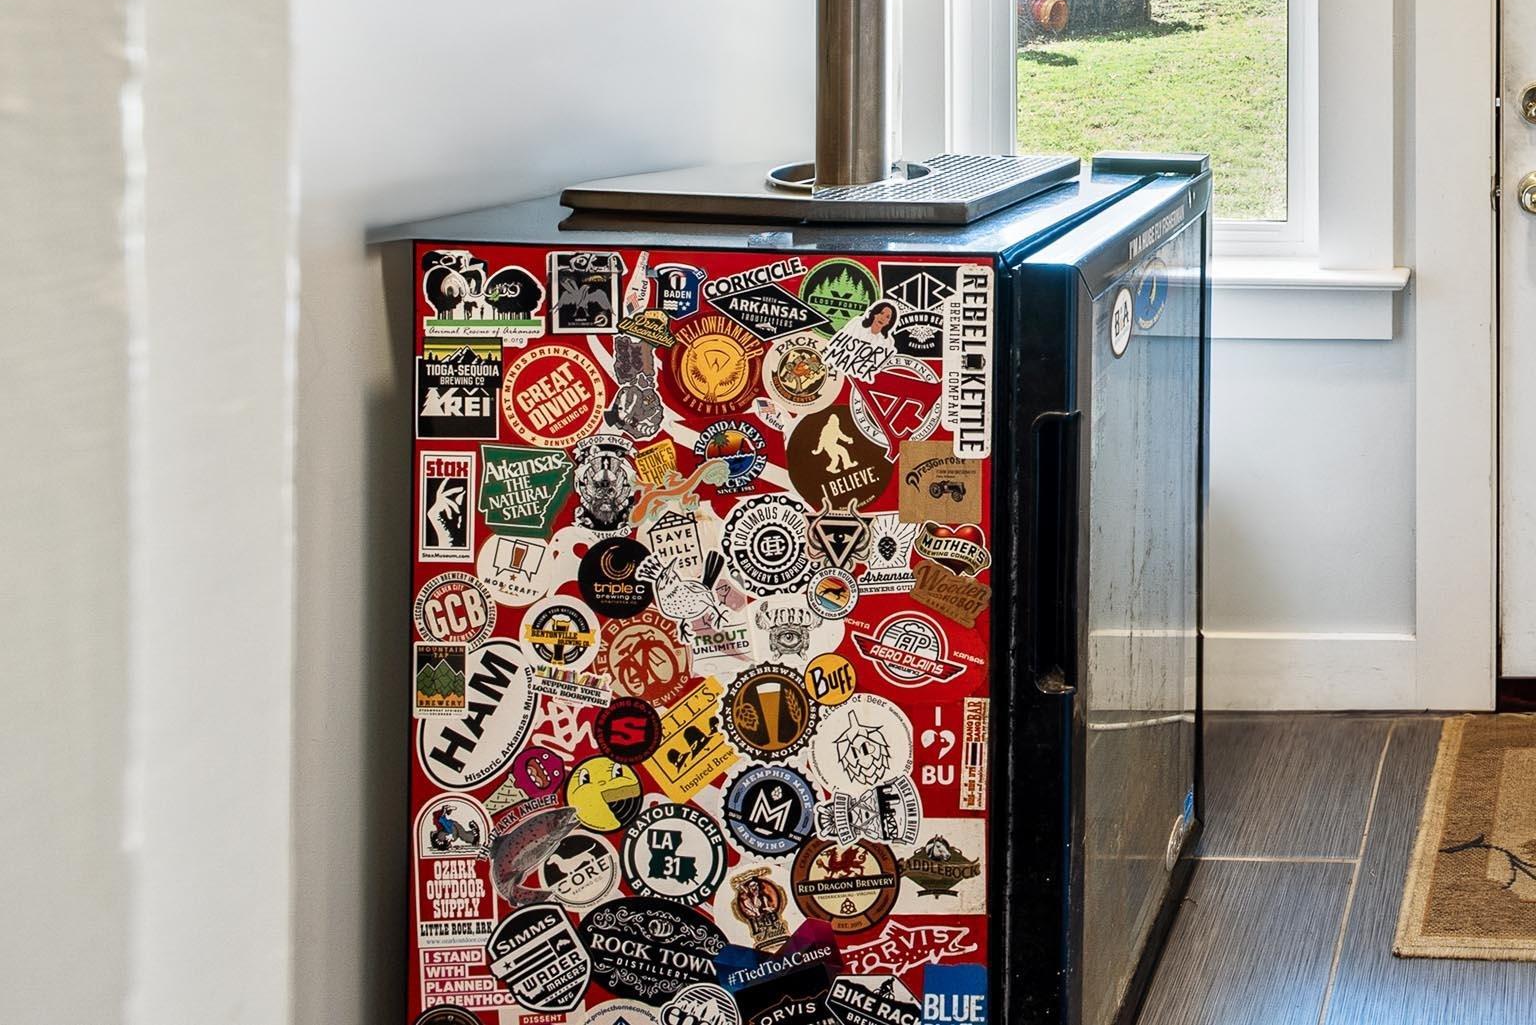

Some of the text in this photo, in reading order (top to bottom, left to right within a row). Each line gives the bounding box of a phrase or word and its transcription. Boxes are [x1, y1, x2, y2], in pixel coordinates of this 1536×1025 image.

[704, 258, 807, 297] CORKCICLE.
[663, 289, 692, 300] BADEN
[814, 297, 865, 311] LOST FORTY
[729, 297, 809, 322] ARKANSAS
[429, 326, 460, 335] Animal
[503, 326, 540, 335] Arkansas
[676, 315, 765, 360] YELLOWHAMMER
[775, 336, 819, 356] PACK
[829, 332, 895, 371] HISTORY
[426, 364, 500, 377] TIOGA-SEQUOIA
[824, 348, 879, 381] MAKER
[948, 302, 961, 425] BREWING COMPANY
[440, 377, 474, 386] BREWING
[504, 347, 600, 435] GREAT MINDS DRINK ALIKE
[516, 361, 576, 412] GREAT
[528, 380, 592, 431] DIVIDE
[682, 393, 736, 415] BREWING
[959, 373, 986, 453] KETTLE
[544, 404, 603, 447] DENVER COLORADO
[550, 411, 580, 434] BREWING
[765, 413, 784, 430] Voted
[854, 397, 879, 437] AVERY
[695, 421, 765, 456] FLORIDA KEYS
[426, 458, 469, 478] stax
[485, 453, 564, 484] Arkansas
[636, 446, 676, 472] STONE'S
[725, 455, 767, 488] CENTER
[820, 467, 881, 498] I BELIEVE.
[503, 476, 532, 492] THE
[488, 485, 551, 510] NATURAL
[502, 501, 542, 521] STATE
[656, 528, 693, 544] SAVE
[734, 507, 778, 547] COLUMBUS
[658, 543, 695, 558] HILL-
[922, 535, 986, 564] MOTHER'S
[740, 558, 772, 584] BREWERY
[859, 571, 915, 584] Arkansas
[414, 598, 424, 621] SECOND
[421, 577, 440, 598] LARGEST
[440, 572, 467, 582] BREWERY
[474, 580, 492, 600] GOLDEN
[433, 584, 451, 598] GOLDEN
[484, 577, 505, 588] MOB
[508, 583, 538, 597] CRAFT
[593, 582, 634, 595] triple
[596, 593, 630, 601] brewing
[859, 585, 894, 594] BREWERS
[424, 588, 487, 639] GCB
[532, 629, 578, 640] BENTONVILLE
[693, 628, 748, 647] TROUT
[597, 642, 610, 674] NEW
[693, 640, 750, 655] UNLIMITED
[953, 650, 985, 665] KANSAS
[870, 644, 944, 675] AERO PLAINS
[541, 679, 602, 698] SUPPORT YOUR
[730, 666, 806, 696] HOMEBREWERS
[532, 684, 557, 696] LOCAL
[560, 689, 609, 706] BOOKSTORE
[866, 695, 888, 708] Beer
[429, 650, 520, 774] HAM
[935, 706, 942, 727] I
[464, 666, 535, 783] Historic Arkansas Museum
[724, 706, 764, 757] AMERICAN
[771, 698, 817, 758] ASSOCIATION
[680, 764, 714, 793] Inspired
[921, 764, 955, 786] BU
[742, 769, 812, 809] MEMPHIS MADE
[897, 779, 913, 798] ROCK
[491, 795, 558, 842] OZARK ANGLER
[835, 795, 852, 843] OUTFITTERS
[906, 799, 918, 817] TOWN
[628, 806, 722, 844] BAYOU TECHE
[903, 820, 918, 842] RIVER
[651, 831, 674, 850] LA
[736, 825, 786, 850] BREWING
[434, 859, 477, 880] OZARK
[557, 858, 611, 895] CORE
[663, 855, 681, 876] 31
[426, 878, 486, 900] OUTDOOR
[432, 897, 480, 919] SUPPLY
[420, 921, 493, 937] LITTLE ROCK, ARK
[496, 914, 557, 955] SIMMS
[424, 950, 482, 963] I STAND
[590, 932, 718, 976] ROCK TOWN
[425, 965, 465, 978] WITH
[522, 950, 583, 992] WADER
[616, 957, 689, 980] DISTILLERY
[728, 945, 832, 987] #TiedToACause
[426, 980, 494, 993] PLANNED
[546, 964, 586, 992] MAKERS
[426, 993, 517, 1008] PARENTHOO
[557, 991, 575, 1005] MFG
[832, 983, 877, 1012] BIKE
[924, 993, 985, 1022] BLUE
[523, 1014, 563, 1024] DISSENT
[760, 1002, 817, 1025] ORVIS
